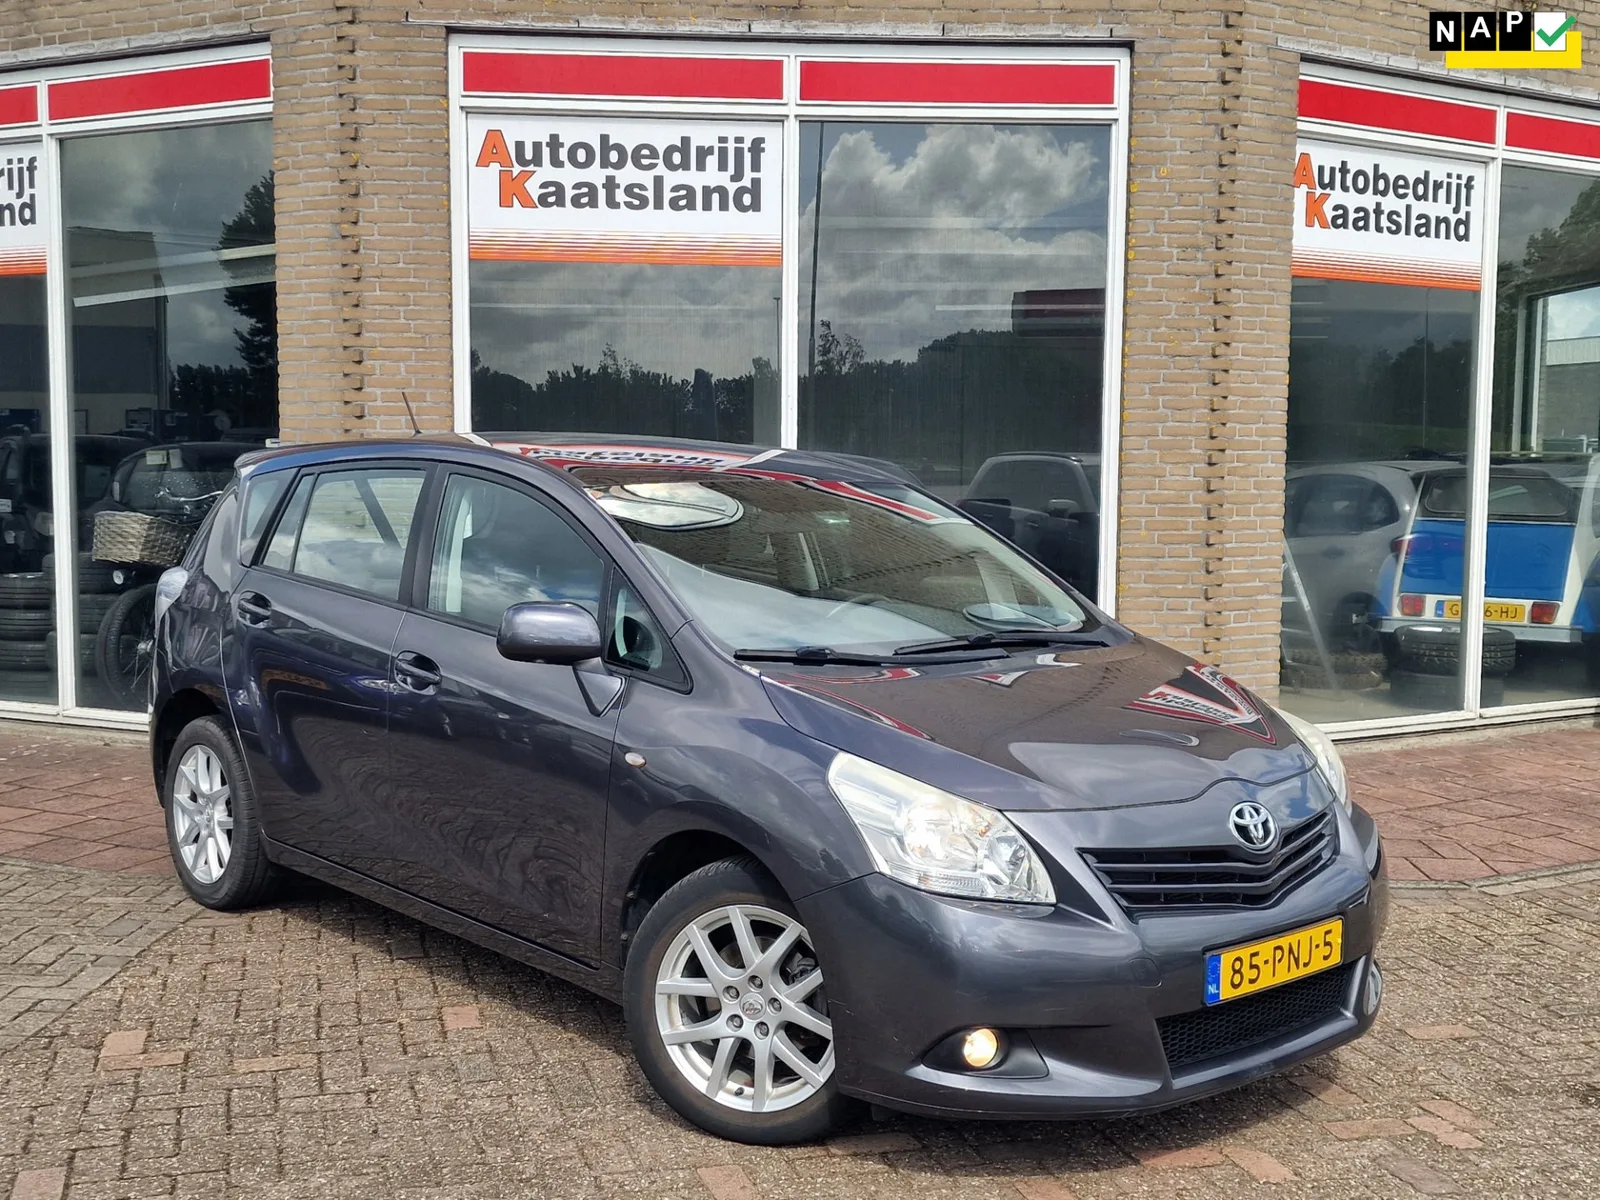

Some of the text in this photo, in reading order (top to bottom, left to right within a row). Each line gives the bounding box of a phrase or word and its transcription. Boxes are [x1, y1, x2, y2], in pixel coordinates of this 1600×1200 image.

[475, 129, 766, 182] Autobedrijf
[499, 169, 762, 213] Kaatsland
[1293, 152, 1475, 214] Autobedrijf
[1305, 190, 1471, 242] Kaatsland
[1208, 929, 1333, 995] NL 85-PNJ-5
